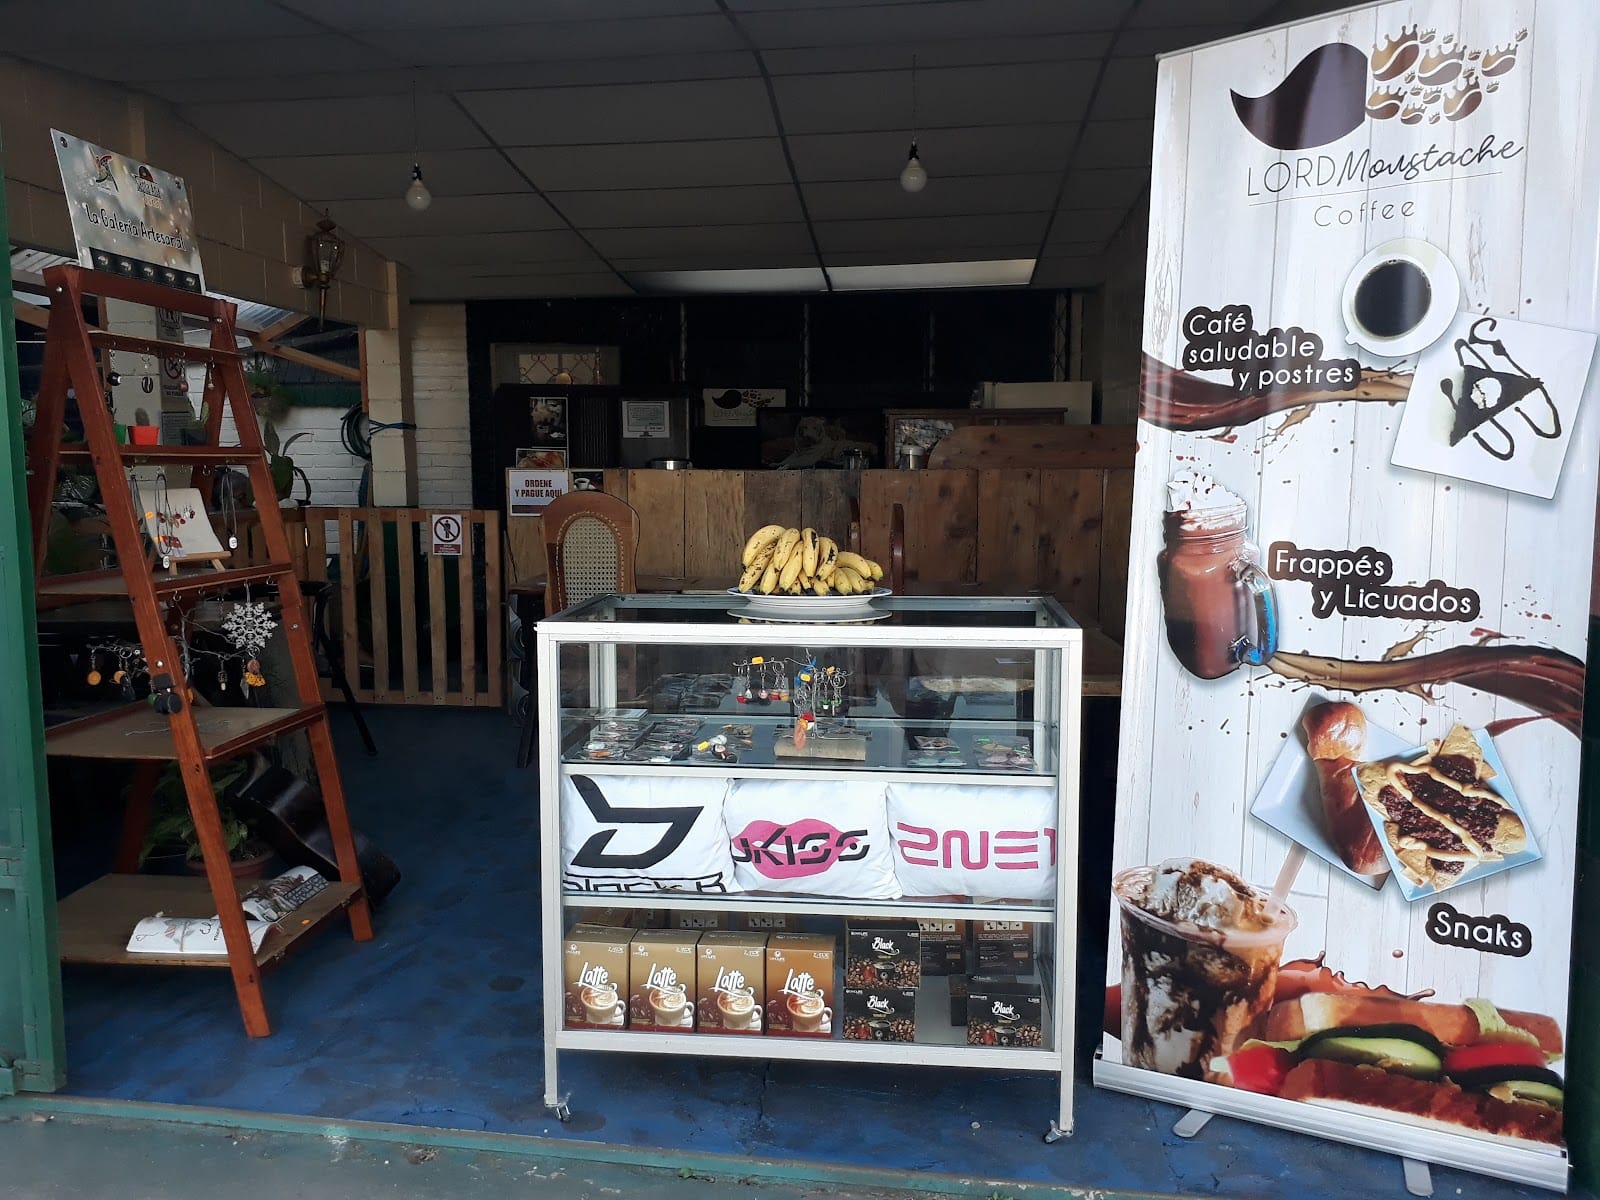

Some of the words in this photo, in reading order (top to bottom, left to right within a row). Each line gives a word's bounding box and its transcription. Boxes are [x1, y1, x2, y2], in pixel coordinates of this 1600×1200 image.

[1248, 155, 1336, 196] LORD
[1336, 134, 1524, 187] Moustache
[1314, 200, 1415, 227] Coffee
[140, 221, 186, 250] Artesanal
[1189, 312, 1247, 336] Café
[1188, 335, 1316, 364] saludable
[1238, 371, 1250, 391] y
[1258, 364, 1354, 390] postres
[514, 489, 520, 498] Y
[521, 489, 544, 498] PAGUE
[525, 479, 553, 488] ORDENE
[1275, 549, 1386, 579] Frappés
[1319, 590, 1334, 611] y
[1344, 584, 1472, 614] Licuados
[1434, 910, 1523, 949] Snaks
[872, 937, 896, 952] Black
[573, 961, 610, 988] Latte
[641, 963, 678, 990] Latte
[709, 966, 746, 993] Latte
[778, 968, 815, 995] Latte
[867, 995, 891, 1010] Black
[992, 1001, 1017, 1016] Black
